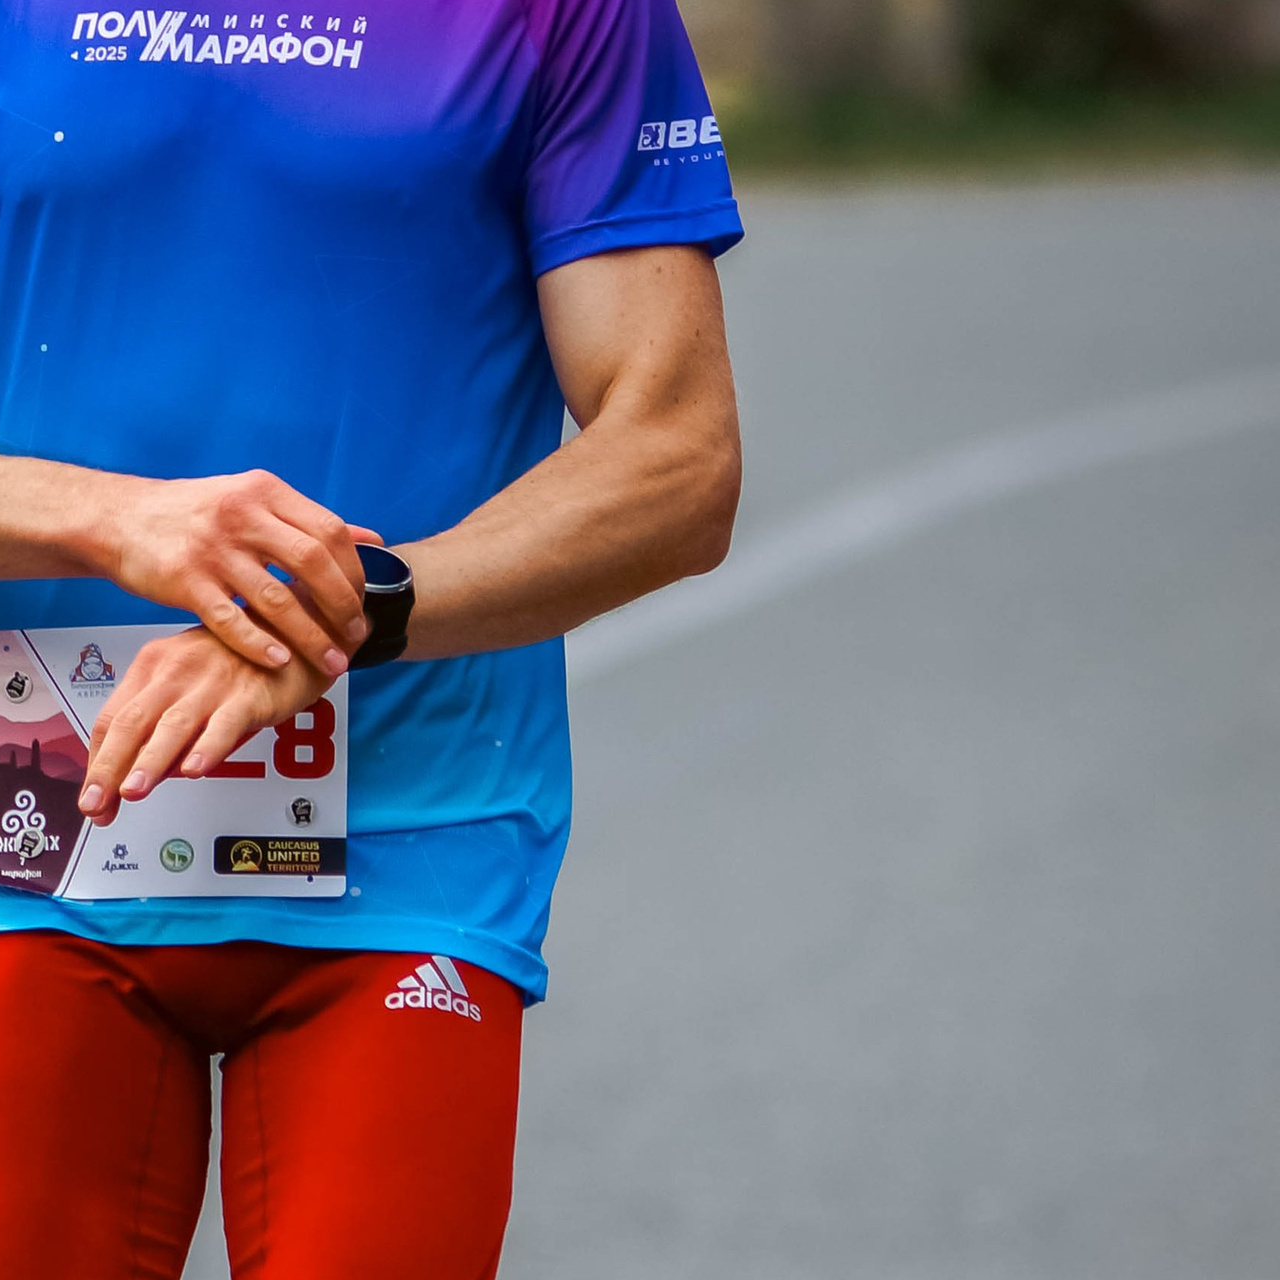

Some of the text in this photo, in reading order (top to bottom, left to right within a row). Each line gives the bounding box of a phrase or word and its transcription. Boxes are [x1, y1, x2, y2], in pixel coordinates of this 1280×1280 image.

[189, 13, 367, 34] МИНСКИЙ
[72, 10, 187, 61] ПОЛУ
[84, 45, 127, 62] 2025
[151, 31, 363, 69] МАРАФОН
[268, 841, 319, 851] CAUCASUS
[267, 851, 320, 862] UNITED
[267, 863, 320, 873] TERRITORY
[384, 985, 482, 1022] adidas
